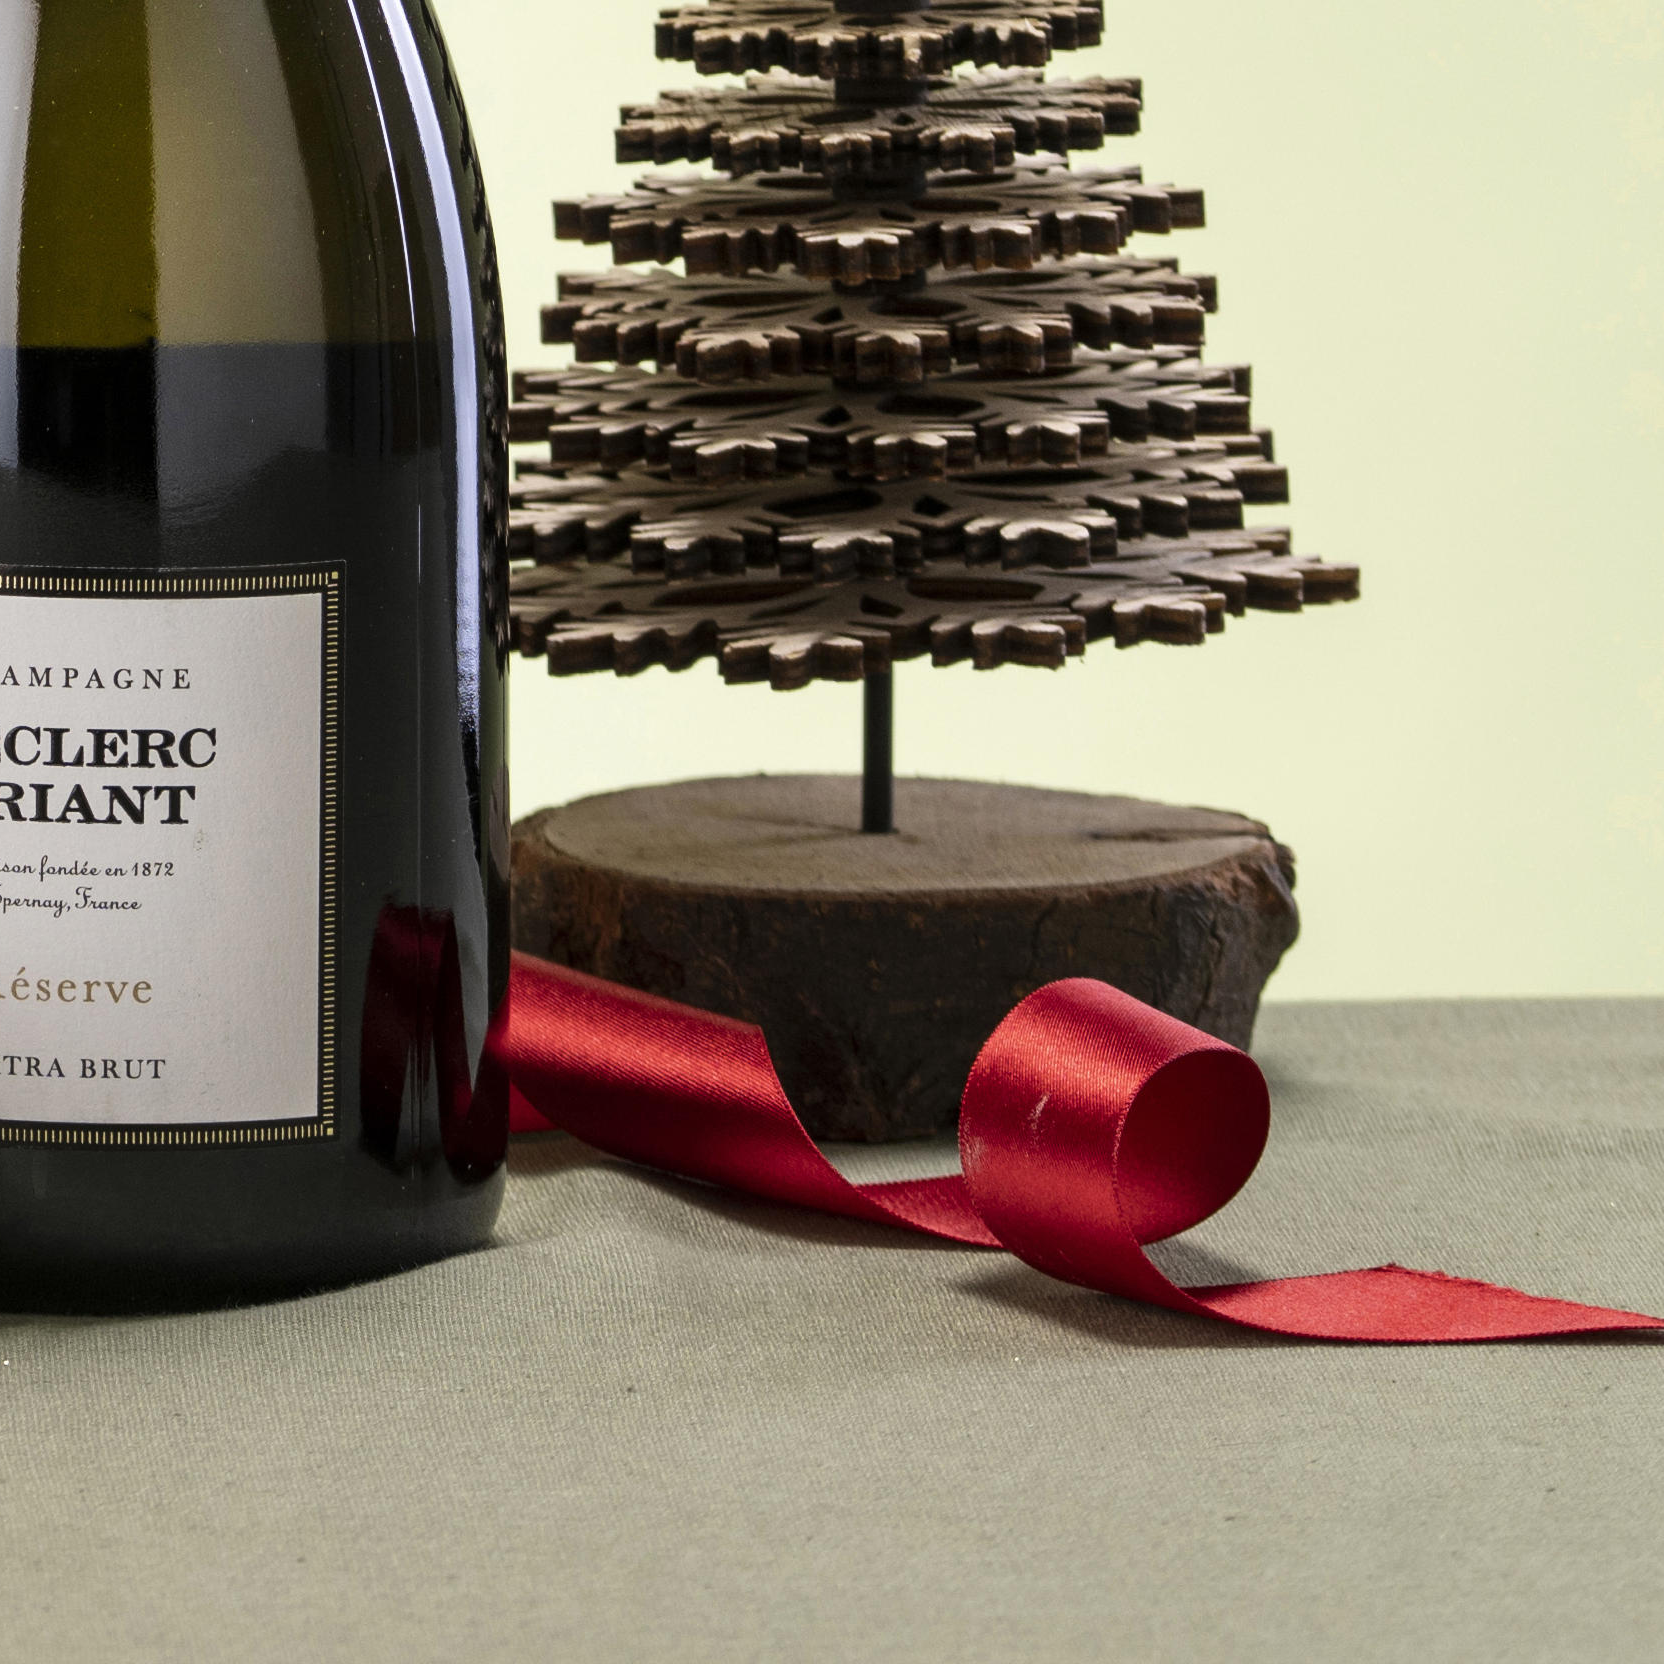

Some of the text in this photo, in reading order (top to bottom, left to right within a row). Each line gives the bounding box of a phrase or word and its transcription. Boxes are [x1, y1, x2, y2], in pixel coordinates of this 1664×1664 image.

[39, 855, 101, 882] fondée
[105, 868, 127, 876] en
[132, 862, 174, 876] 1872
[75, 887, 142, 909] France
[80, 1059, 165, 1079] BRUT
